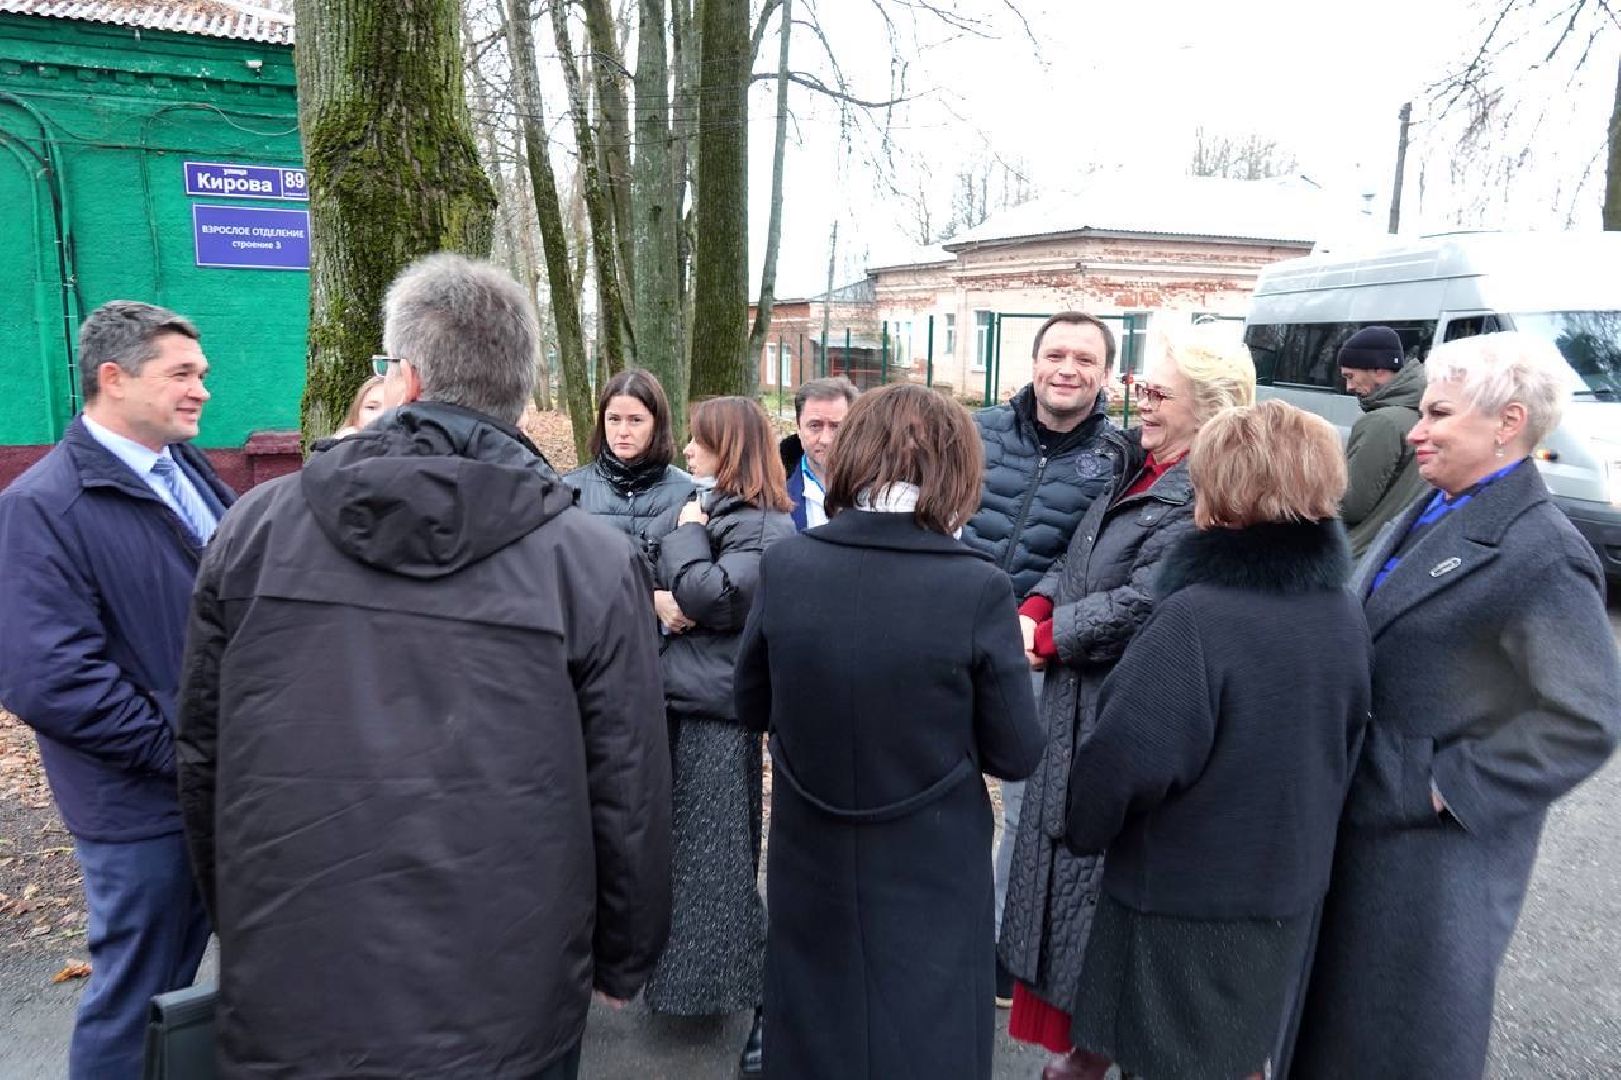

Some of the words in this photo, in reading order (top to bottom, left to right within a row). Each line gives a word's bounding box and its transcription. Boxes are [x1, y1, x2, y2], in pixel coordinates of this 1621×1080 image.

[197, 172, 273, 193] Кирова
[285, 172, 305, 189] 89
[201, 225, 250, 235] ВЗРОСЛОЕ
[252, 228, 304, 239] ОТДЕЛЕНИЕ
[232, 241, 274, 250] строение
